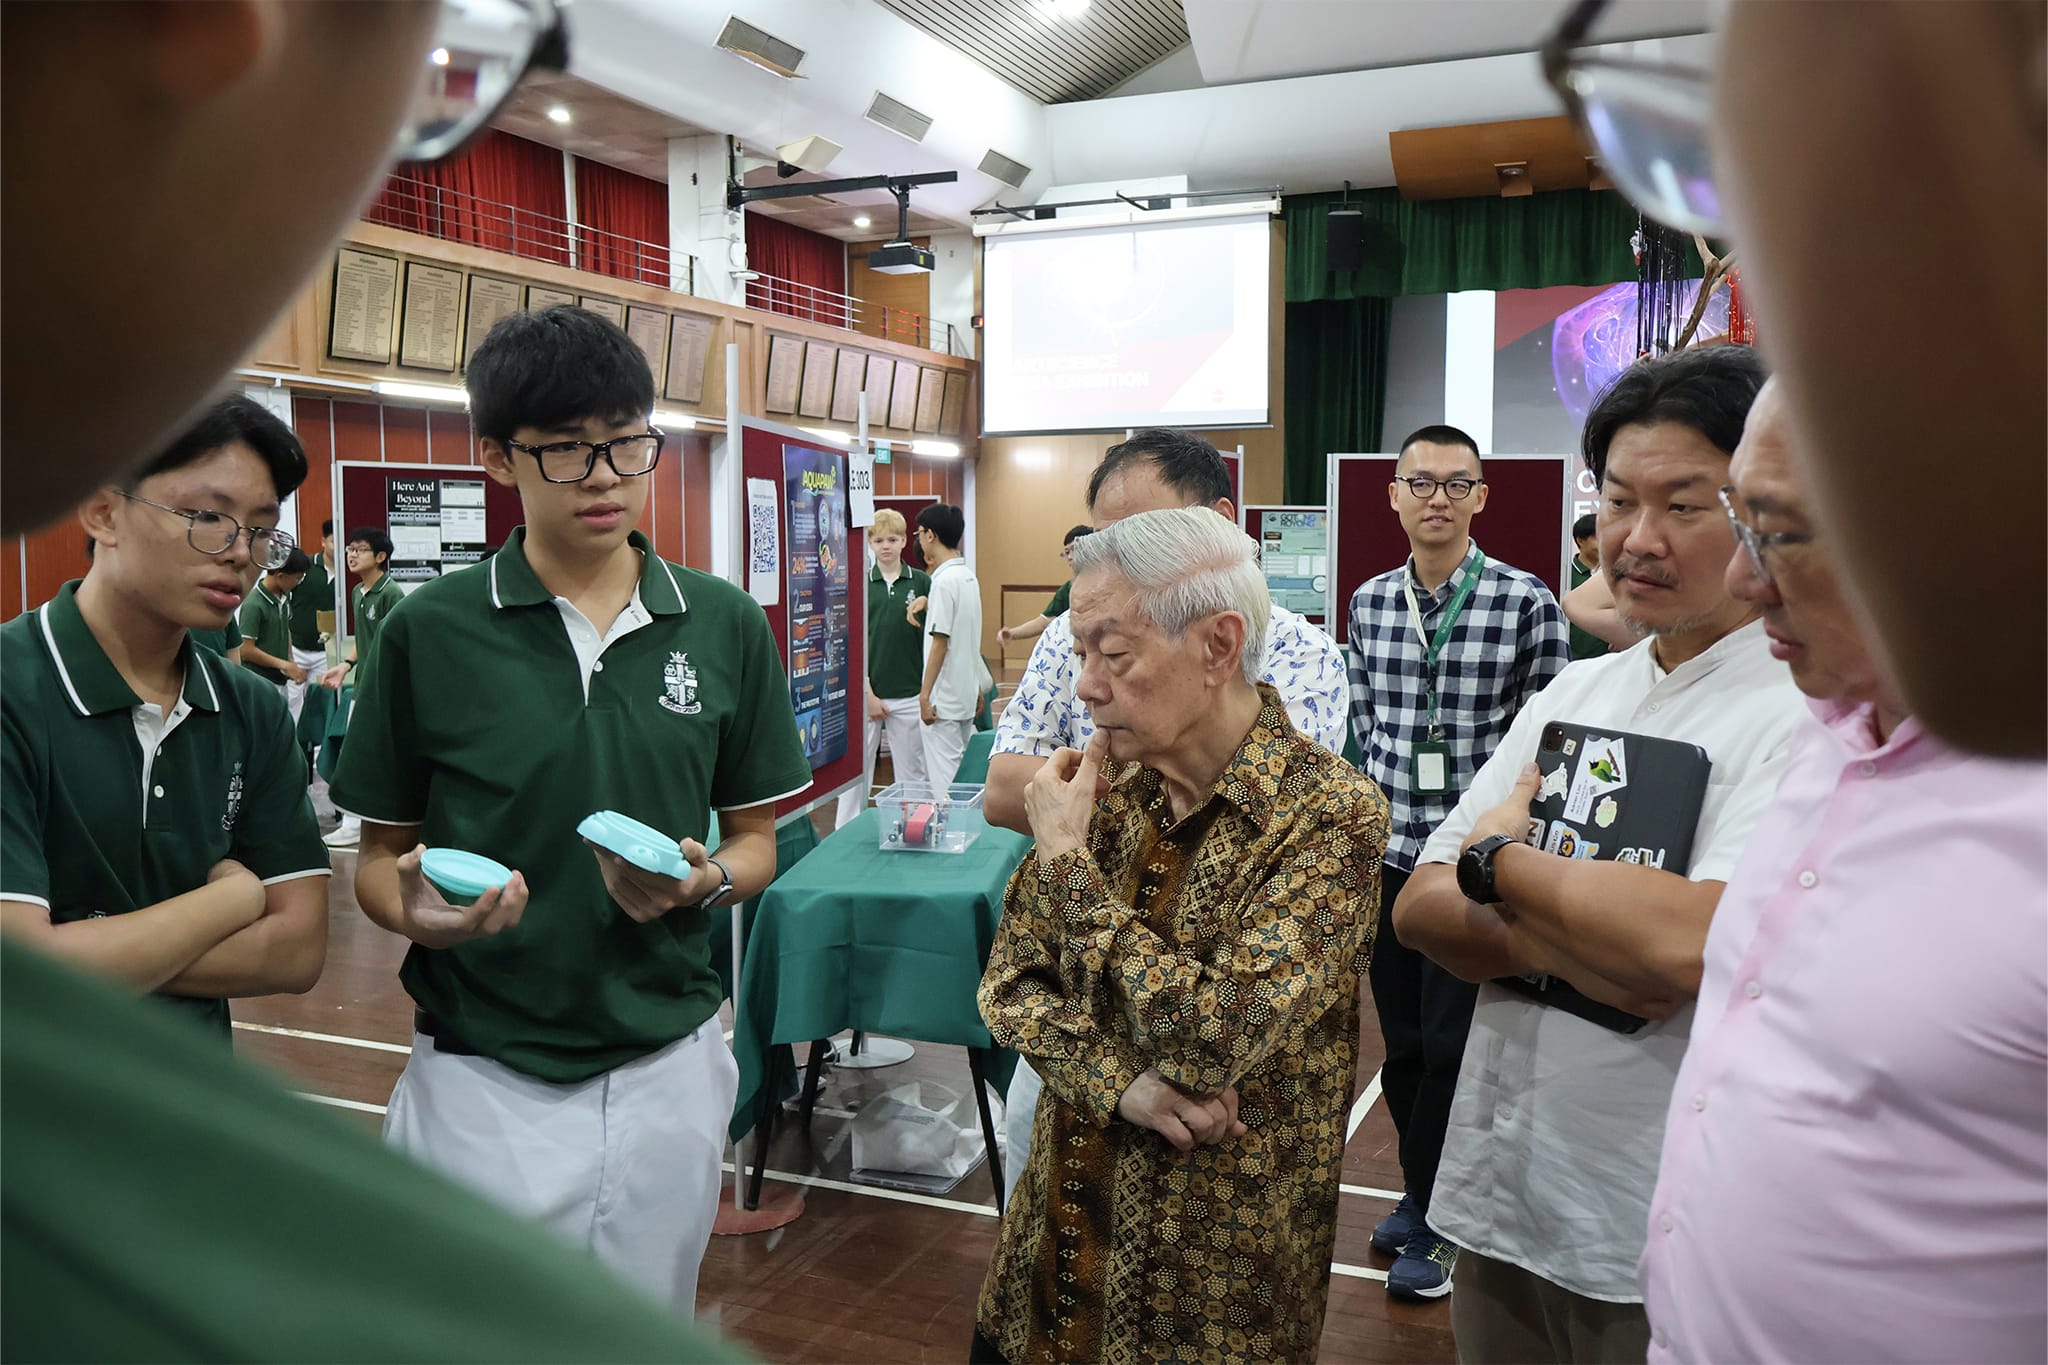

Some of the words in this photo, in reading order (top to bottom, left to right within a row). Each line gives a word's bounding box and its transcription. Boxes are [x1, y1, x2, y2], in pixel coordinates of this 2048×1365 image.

[393, 481, 415, 491] Here
[416, 481, 434, 491] And
[397, 493, 431, 505] Beyond
